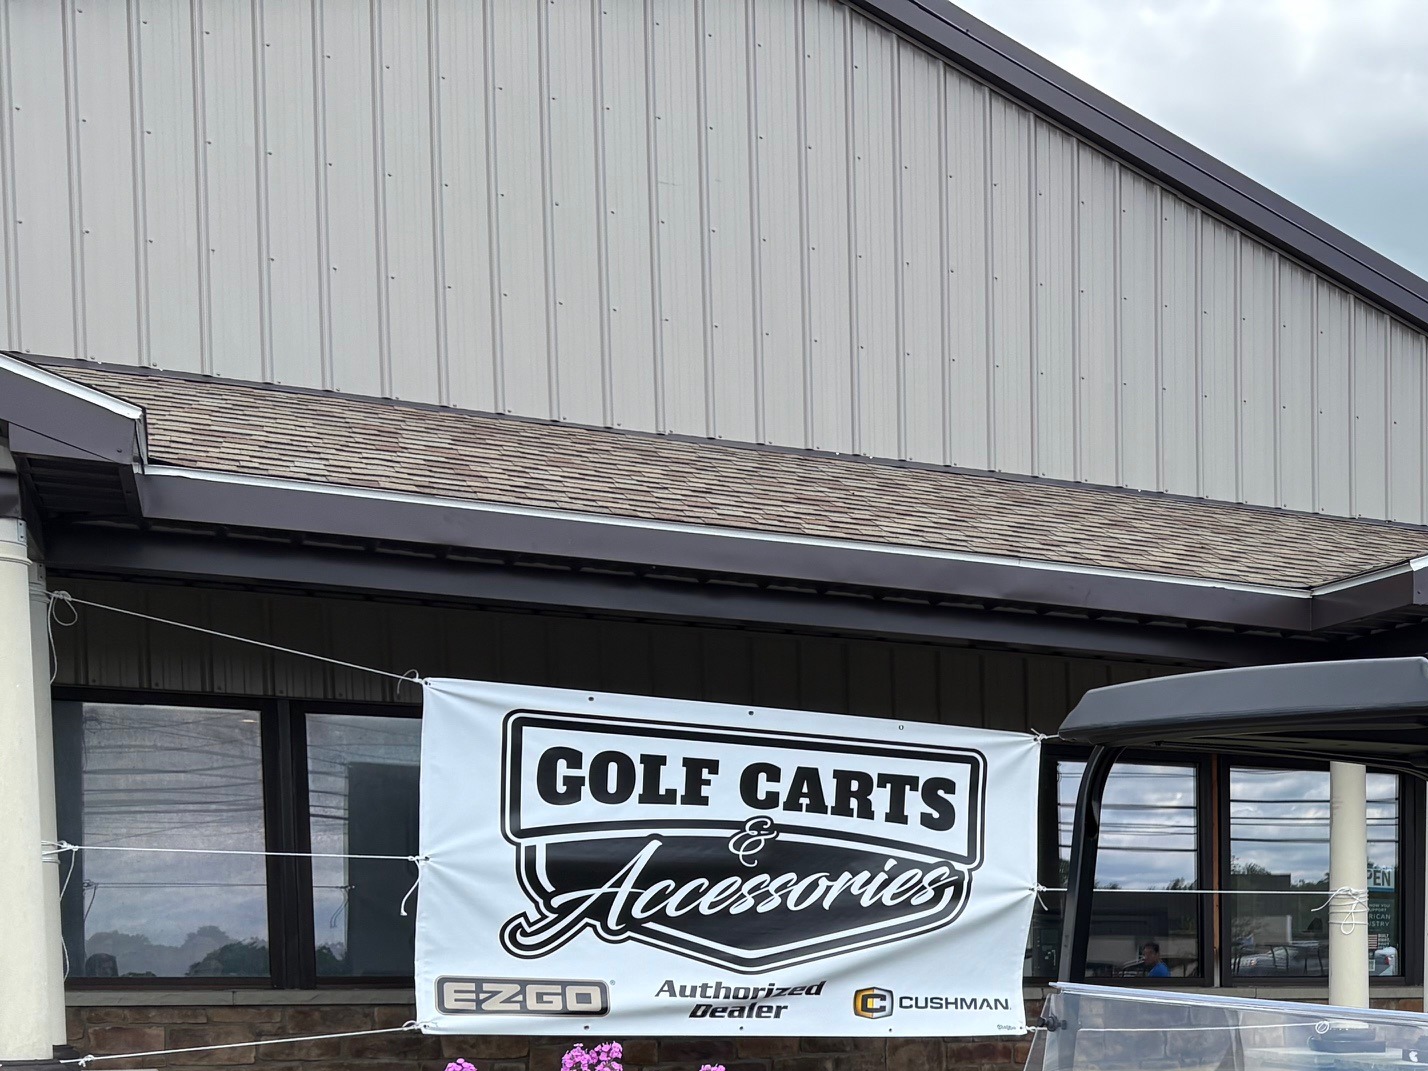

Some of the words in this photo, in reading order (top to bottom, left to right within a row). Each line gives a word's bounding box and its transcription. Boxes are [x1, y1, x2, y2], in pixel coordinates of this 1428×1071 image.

[537, 746, 719, 806] GOLF
[739, 762, 957, 831] CARTS
[728, 817, 777, 868] &
[514, 838, 959, 946] Accessories
[443, 982, 601, 1011] EZGO
[654, 979, 828, 1000] Authorized
[899, 996, 1009, 1010] CUSHMAN
[688, 1002, 788, 1019] Dealer
